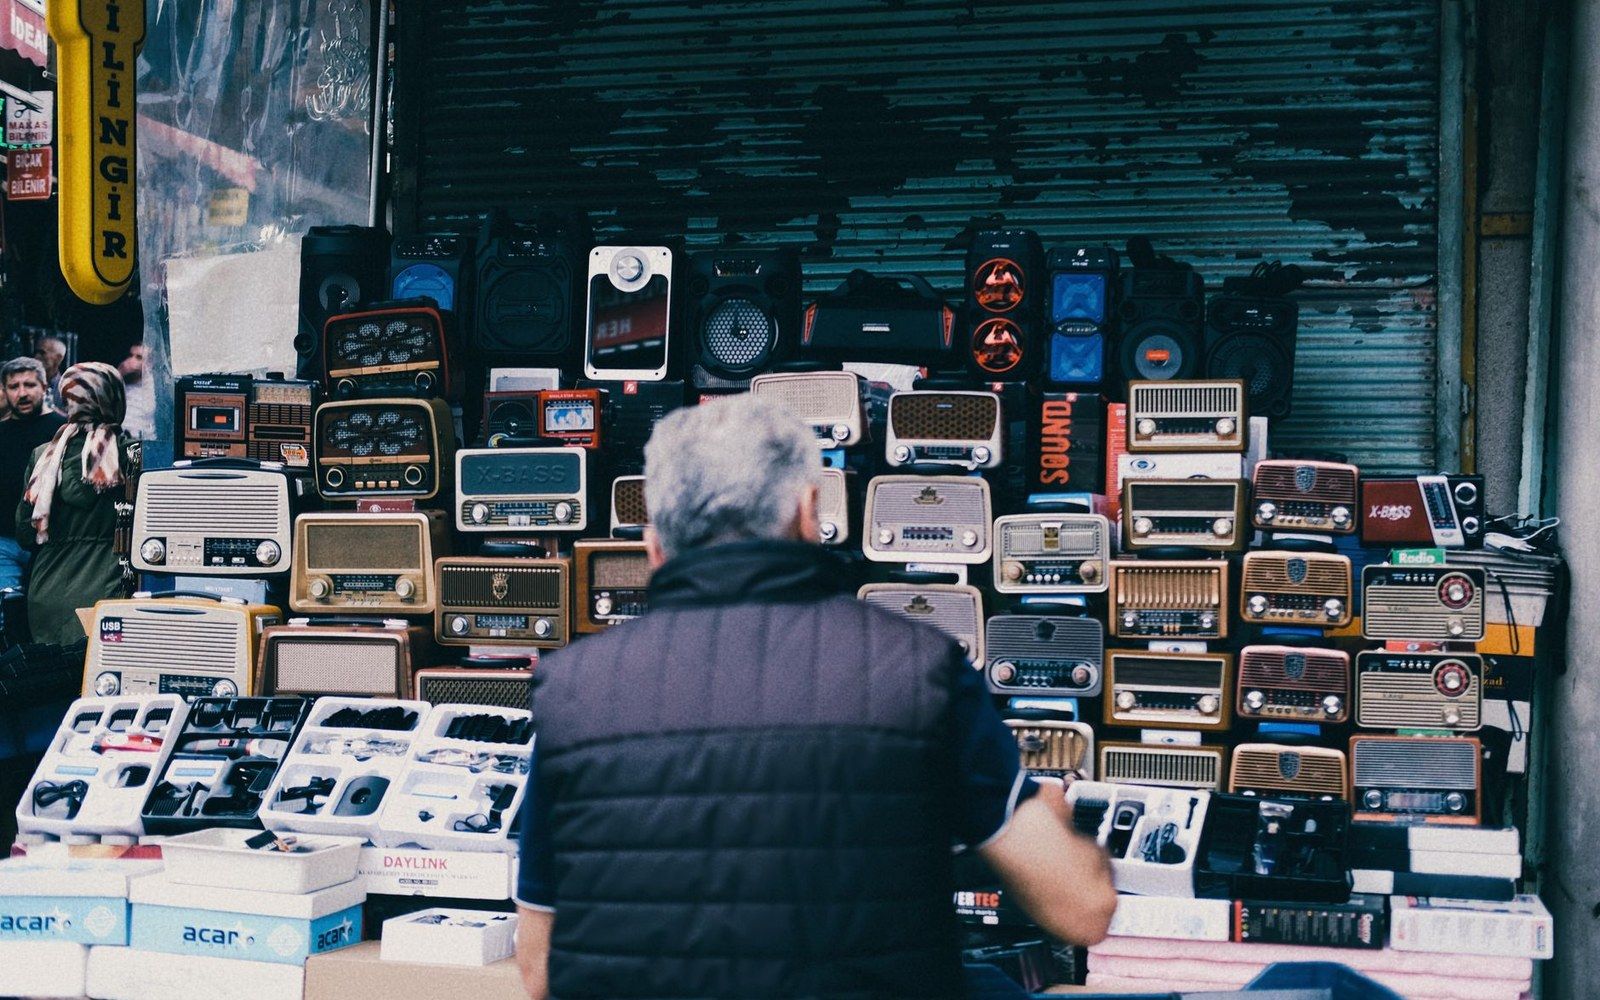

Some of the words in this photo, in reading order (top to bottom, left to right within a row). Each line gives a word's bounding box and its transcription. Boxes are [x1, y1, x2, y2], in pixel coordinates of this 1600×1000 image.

[9, 121, 48, 130] MAKAS
[11, 176, 46, 195] BİLENİR
[1041, 401, 1072, 484] SOUND
[477, 464, 567, 483] X-BASS
[1398, 551, 1436, 564] Radio
[101, 621, 121, 631] USB
[383, 855, 448, 870] DAYLINK
[953, 891, 999, 908] ERTEC
[0, 915, 56, 931] acar
[183, 925, 239, 945] acar
